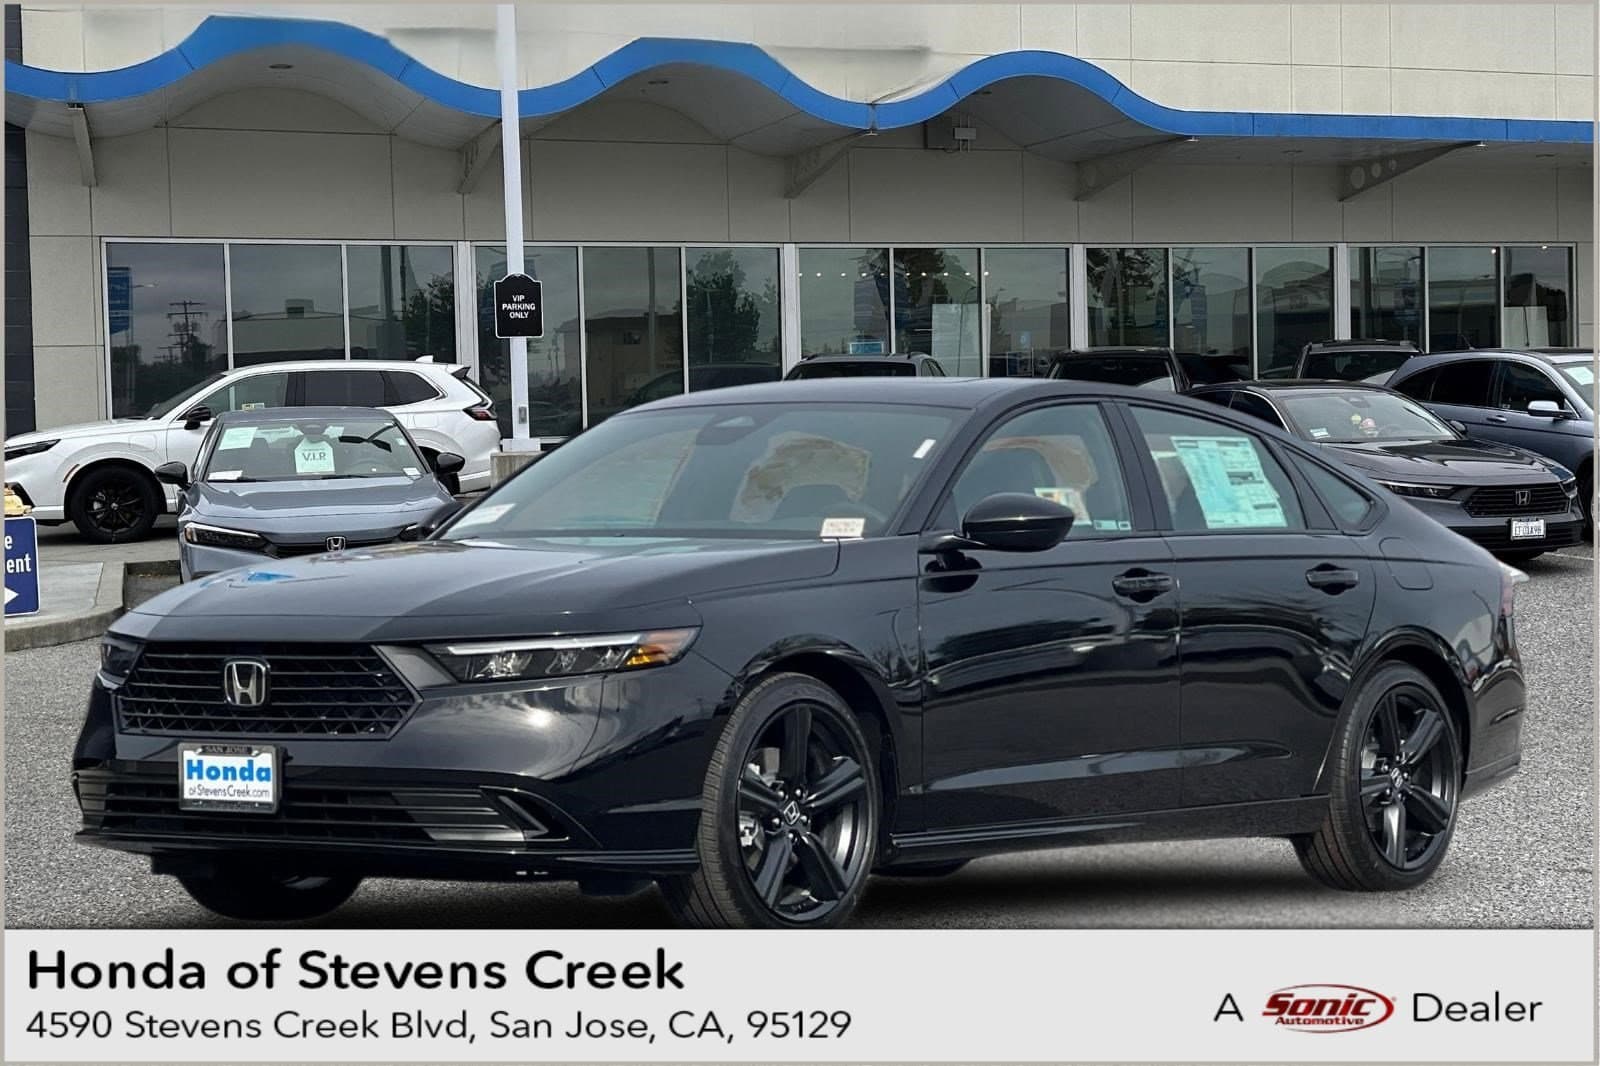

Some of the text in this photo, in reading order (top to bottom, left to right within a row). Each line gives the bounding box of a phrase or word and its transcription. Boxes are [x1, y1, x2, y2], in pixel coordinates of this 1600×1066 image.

[512, 294, 525, 302] VIP
[502, 303, 536, 311] PARKING
[509, 311, 529, 319] ONLY
[186, 759, 271, 782] Honda
